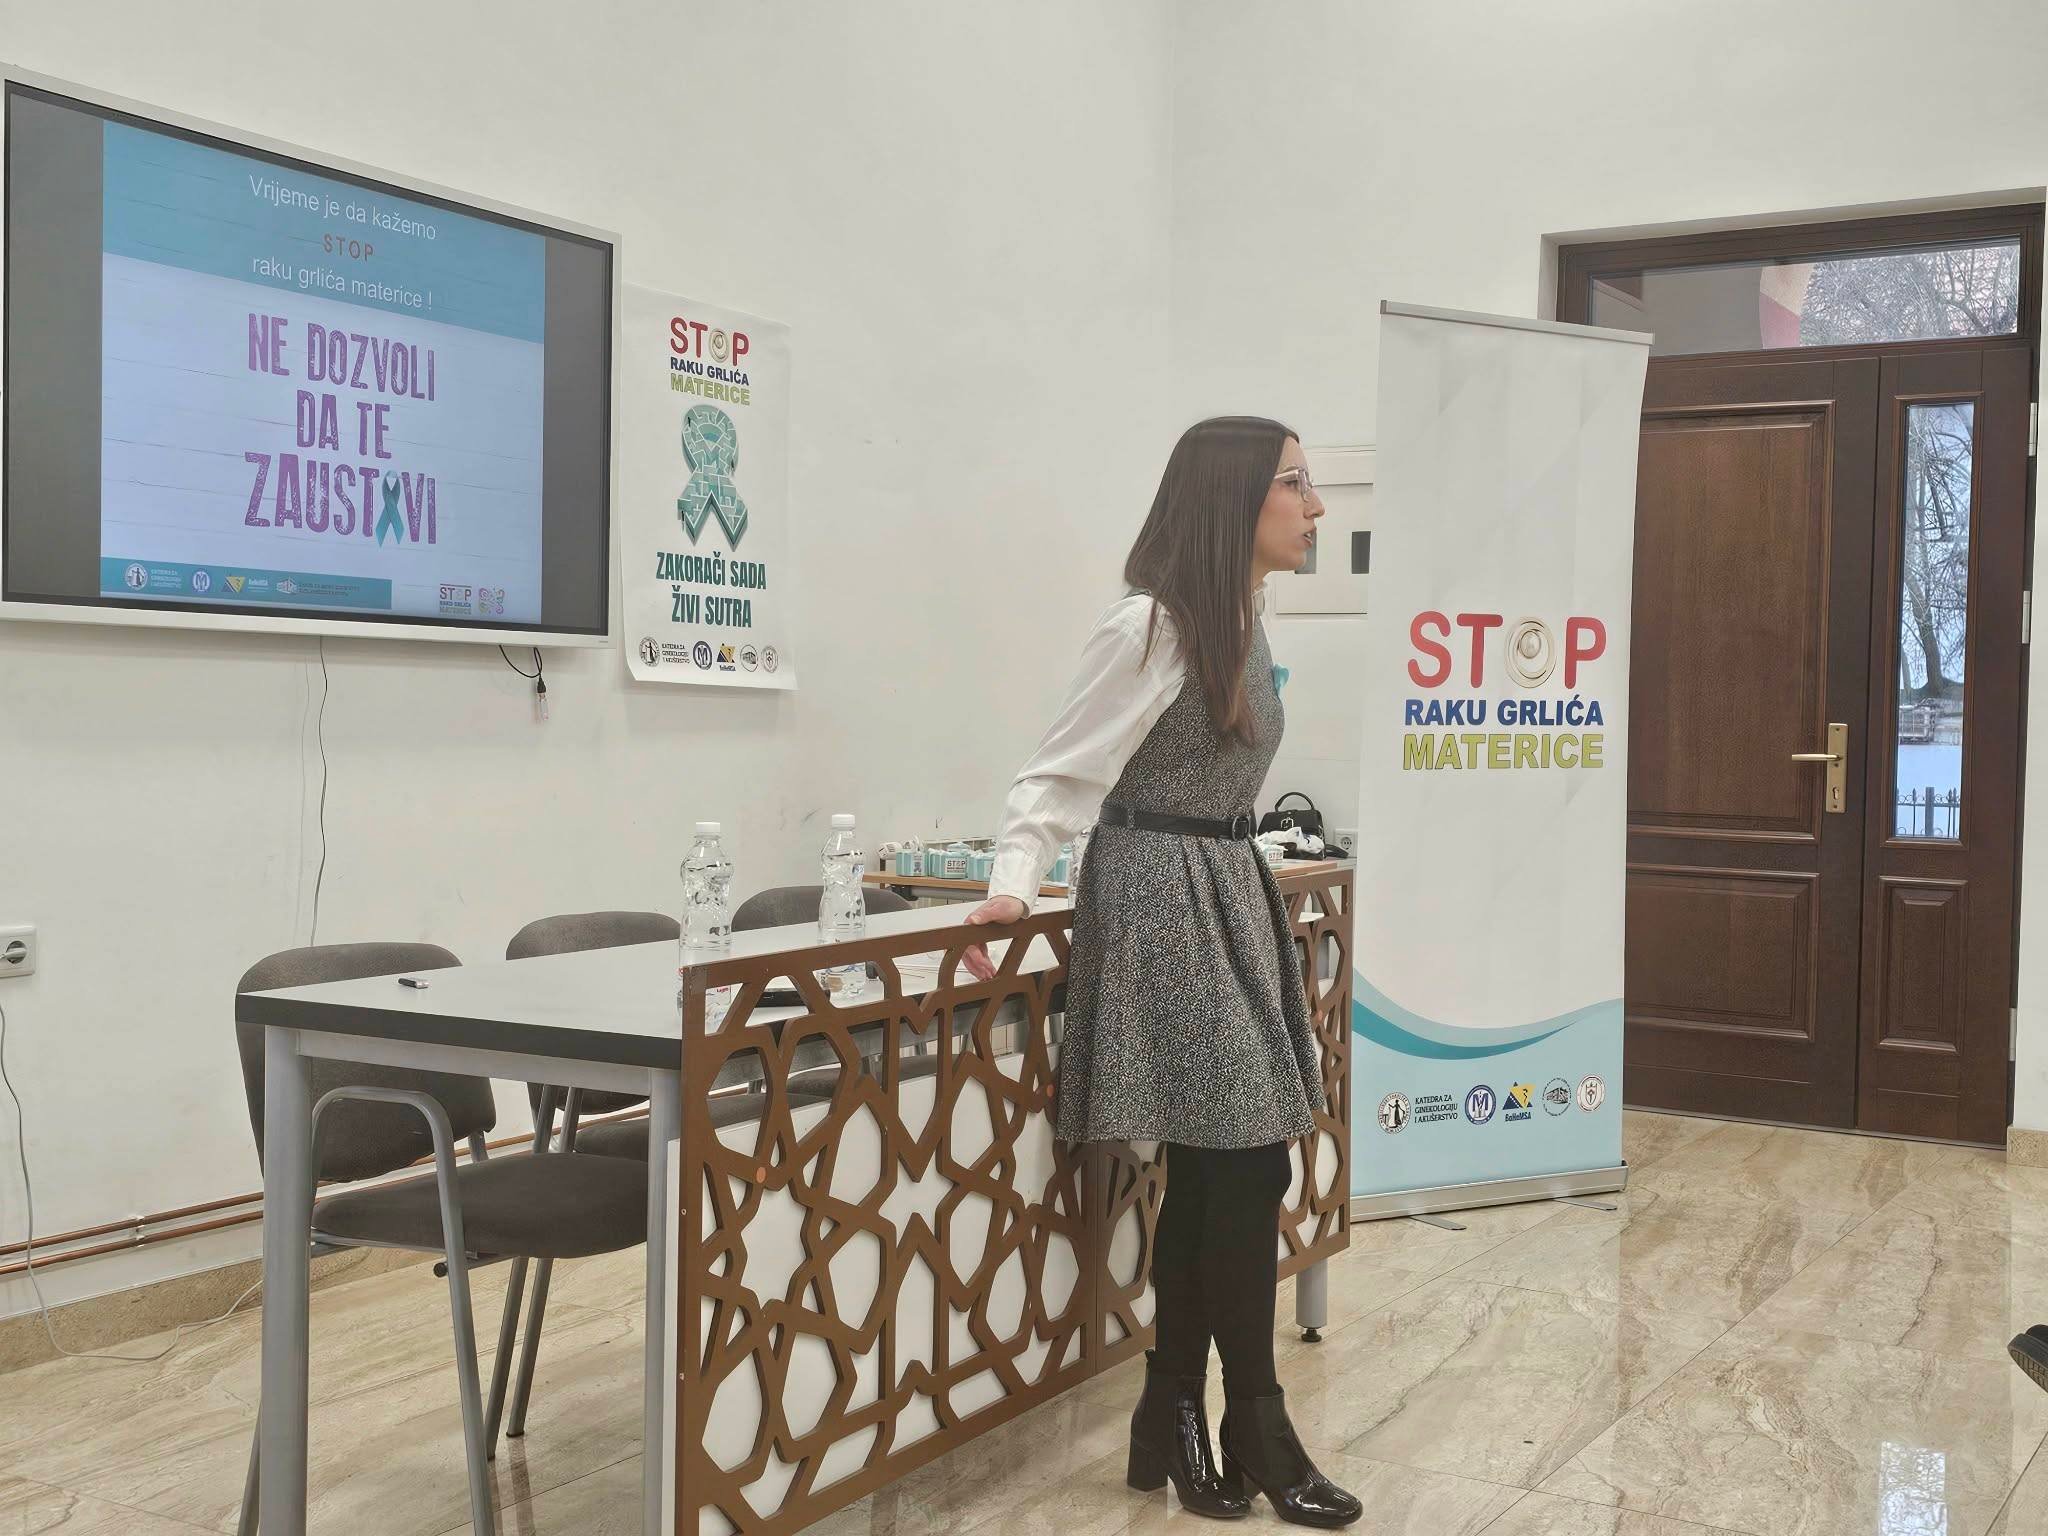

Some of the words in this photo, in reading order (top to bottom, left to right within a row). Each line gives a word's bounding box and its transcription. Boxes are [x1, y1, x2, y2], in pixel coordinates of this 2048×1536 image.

[250, 174, 320, 211] Vrijeme
[323, 195, 340, 219] je
[345, 202, 366, 224] da
[372, 206, 437, 240] kažemo
[323, 233, 374, 262] STOP
[252, 256, 292, 280] raku
[299, 267, 345, 292] grlića
[351, 279, 422, 308] materice
[248, 313, 290, 376] NE
[307, 322, 435, 401] DOZVOLI
[670, 316, 750, 366] STOP
[670, 356, 703, 375] RAKU
[706, 366, 750, 386] GRLIĆA
[670, 372, 750, 406] MATERICE
[296, 389, 339, 451] DA
[356, 401, 392, 459] TE
[655, 550, 726, 586] ZAKORAČI
[730, 560, 767, 590] SADA
[671, 584, 701, 625] ŽIVI
[704, 595, 752, 628] SUTRA
[1407, 611, 1607, 690] STOP
[1405, 699, 1487, 726] RAKU
[1497, 694, 1604, 726] GRLIĆA
[1403, 734, 1604, 770] MATERICE
[1414, 1103, 1458, 1114] GINEKOLOGIJU
[1415, 1096, 1443, 1105] KATEDRA
[1444, 1094, 1453, 1102] ZA
[1419, 1112, 1459, 1123] AKUŠERSTVO
